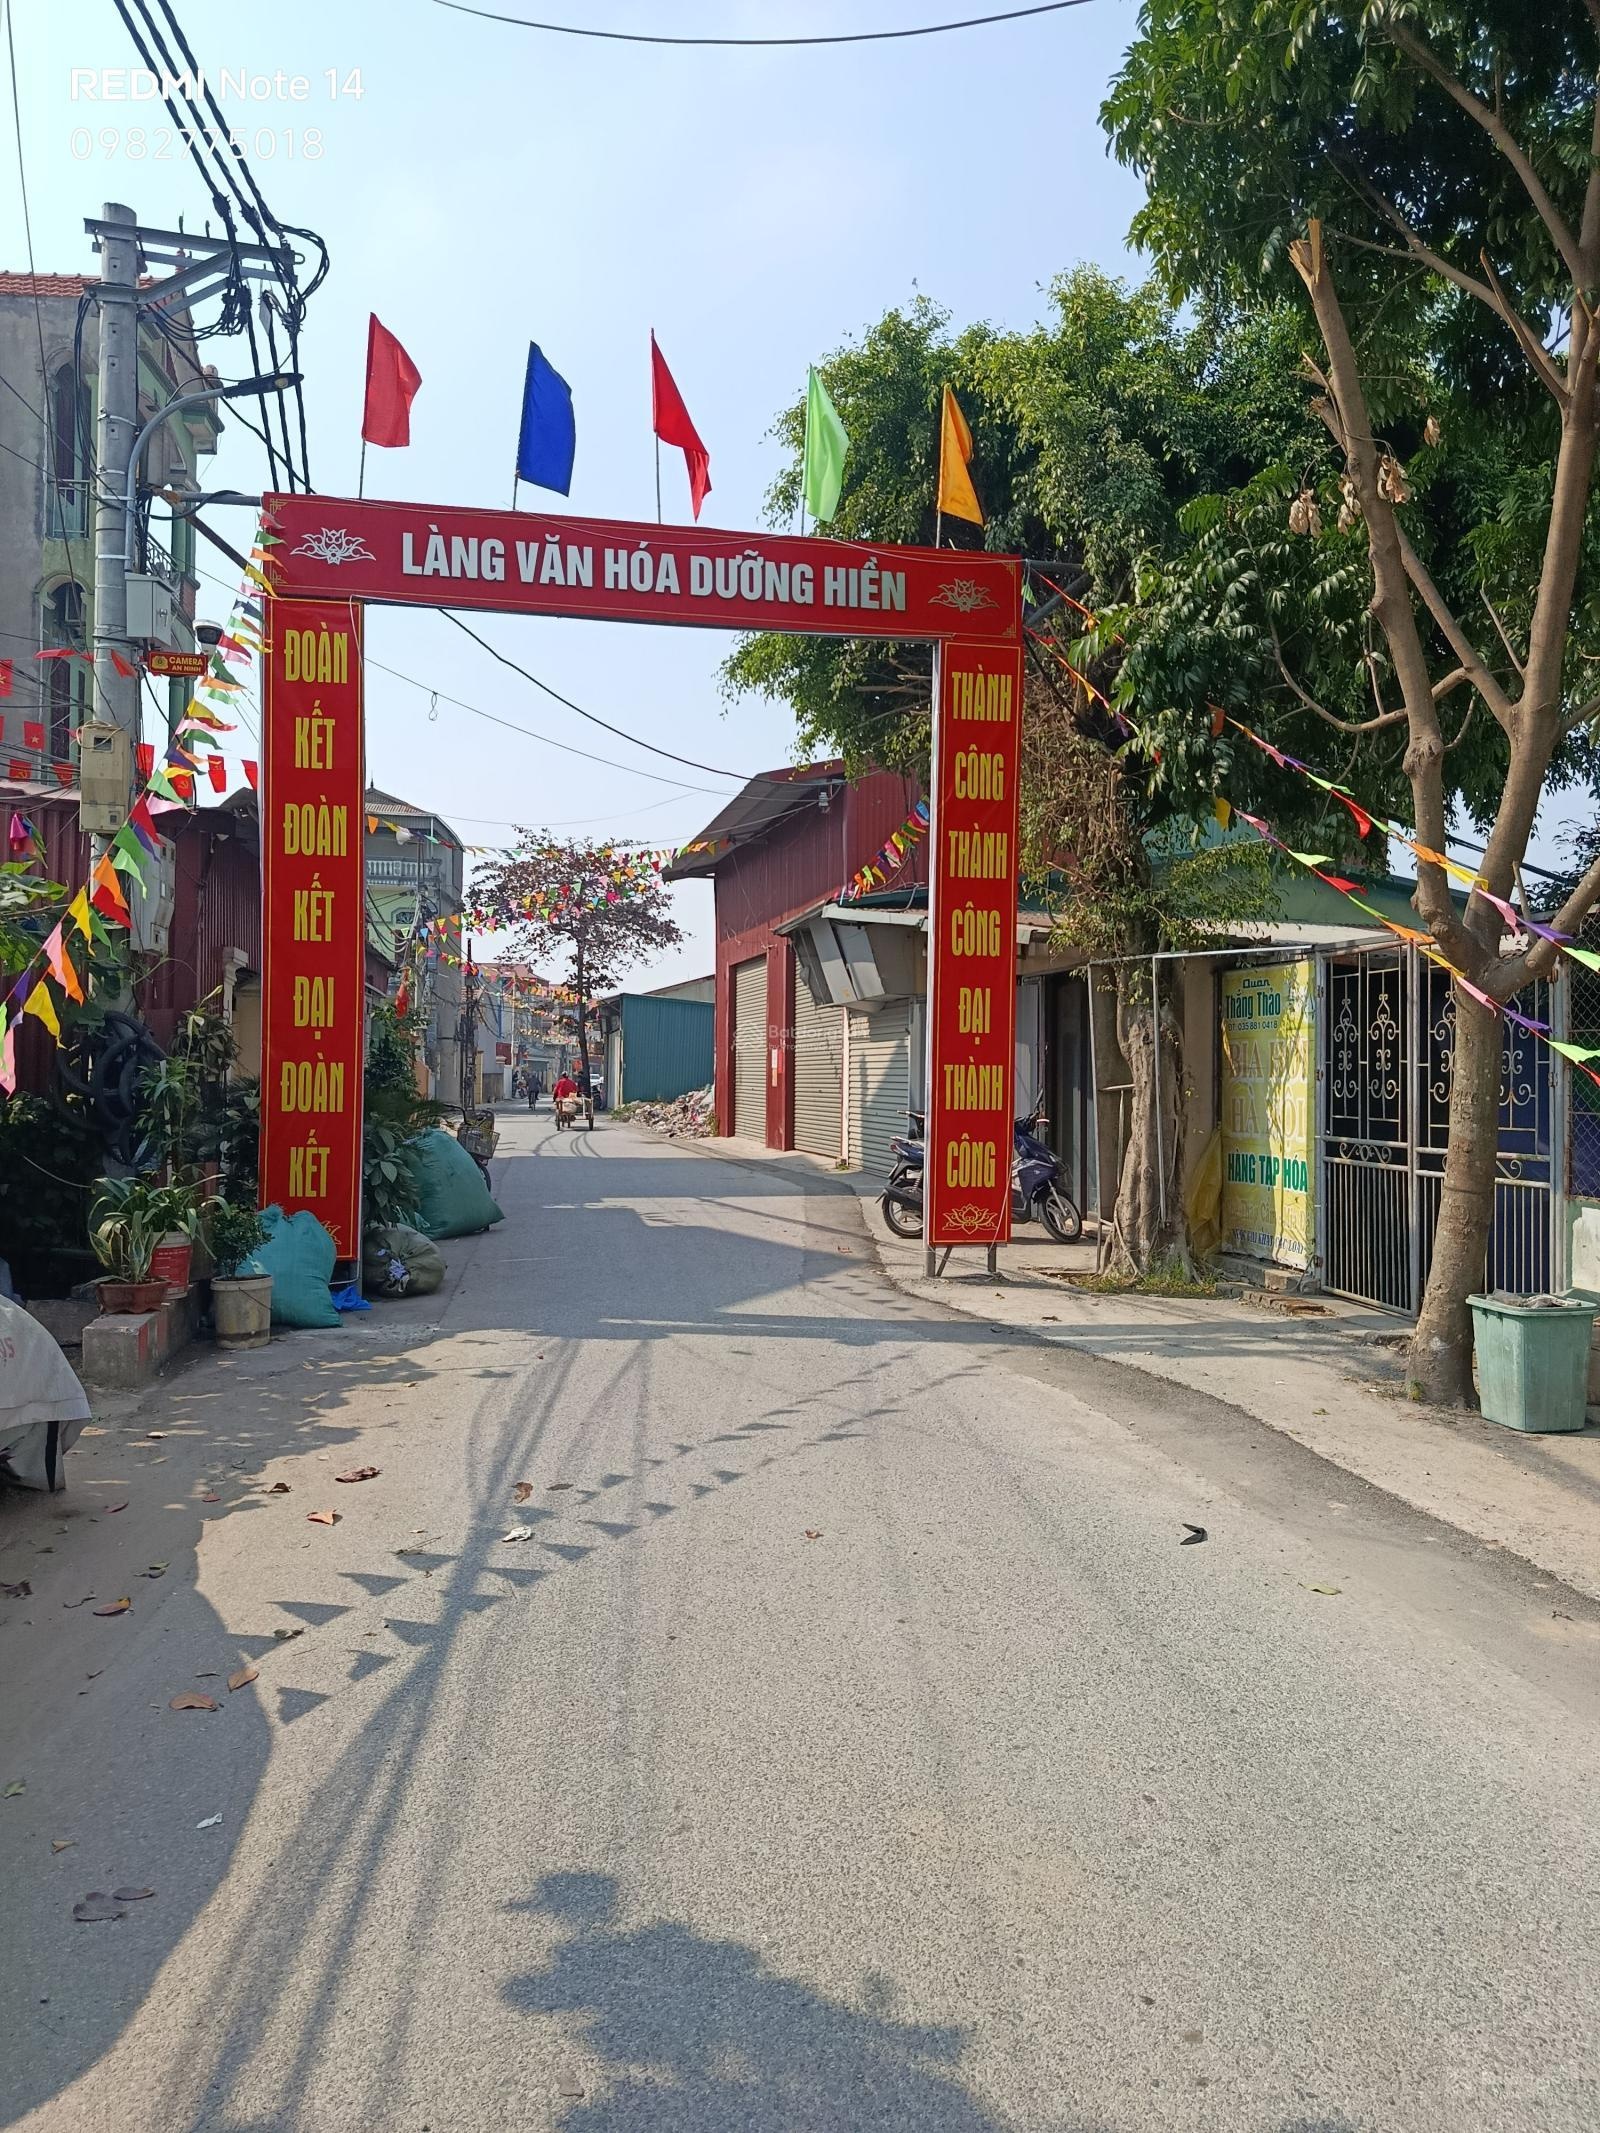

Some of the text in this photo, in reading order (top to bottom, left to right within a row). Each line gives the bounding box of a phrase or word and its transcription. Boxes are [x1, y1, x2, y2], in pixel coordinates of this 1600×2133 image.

[402, 525, 906, 611] LÀNG VĂN HÓA DƯỠNG HIỀN
[169, 656, 203, 666] CAMERA
[284, 622, 348, 684] ĐOÀN
[952, 664, 1013, 722] THÀNH
[295, 700, 336, 770] KẾT
[955, 744, 1004, 801] CÔNG
[283, 795, 347, 857] ĐOÀN
[948, 823, 1008, 879] THÀNH
[293, 873, 335, 942] KẾT
[951, 901, 1001, 958] CÔNG
[293, 976, 335, 1040] ĐẠI
[958, 988, 991, 1045] ĐẠI
[1226, 986, 1281, 1020] Thắng Thảo
[280, 1053, 344, 1113] ĐOÀN
[944, 1055, 1003, 1111] THÀNH
[1230, 1040, 1263, 1079] BIA
[1231, 1083, 1260, 1134] HÀ
[289, 1129, 330, 1198] KẾT
[946, 1133, 996, 1188] CÔNG
[1228, 1149, 1308, 1193] HÀNG TẠP HÓA
